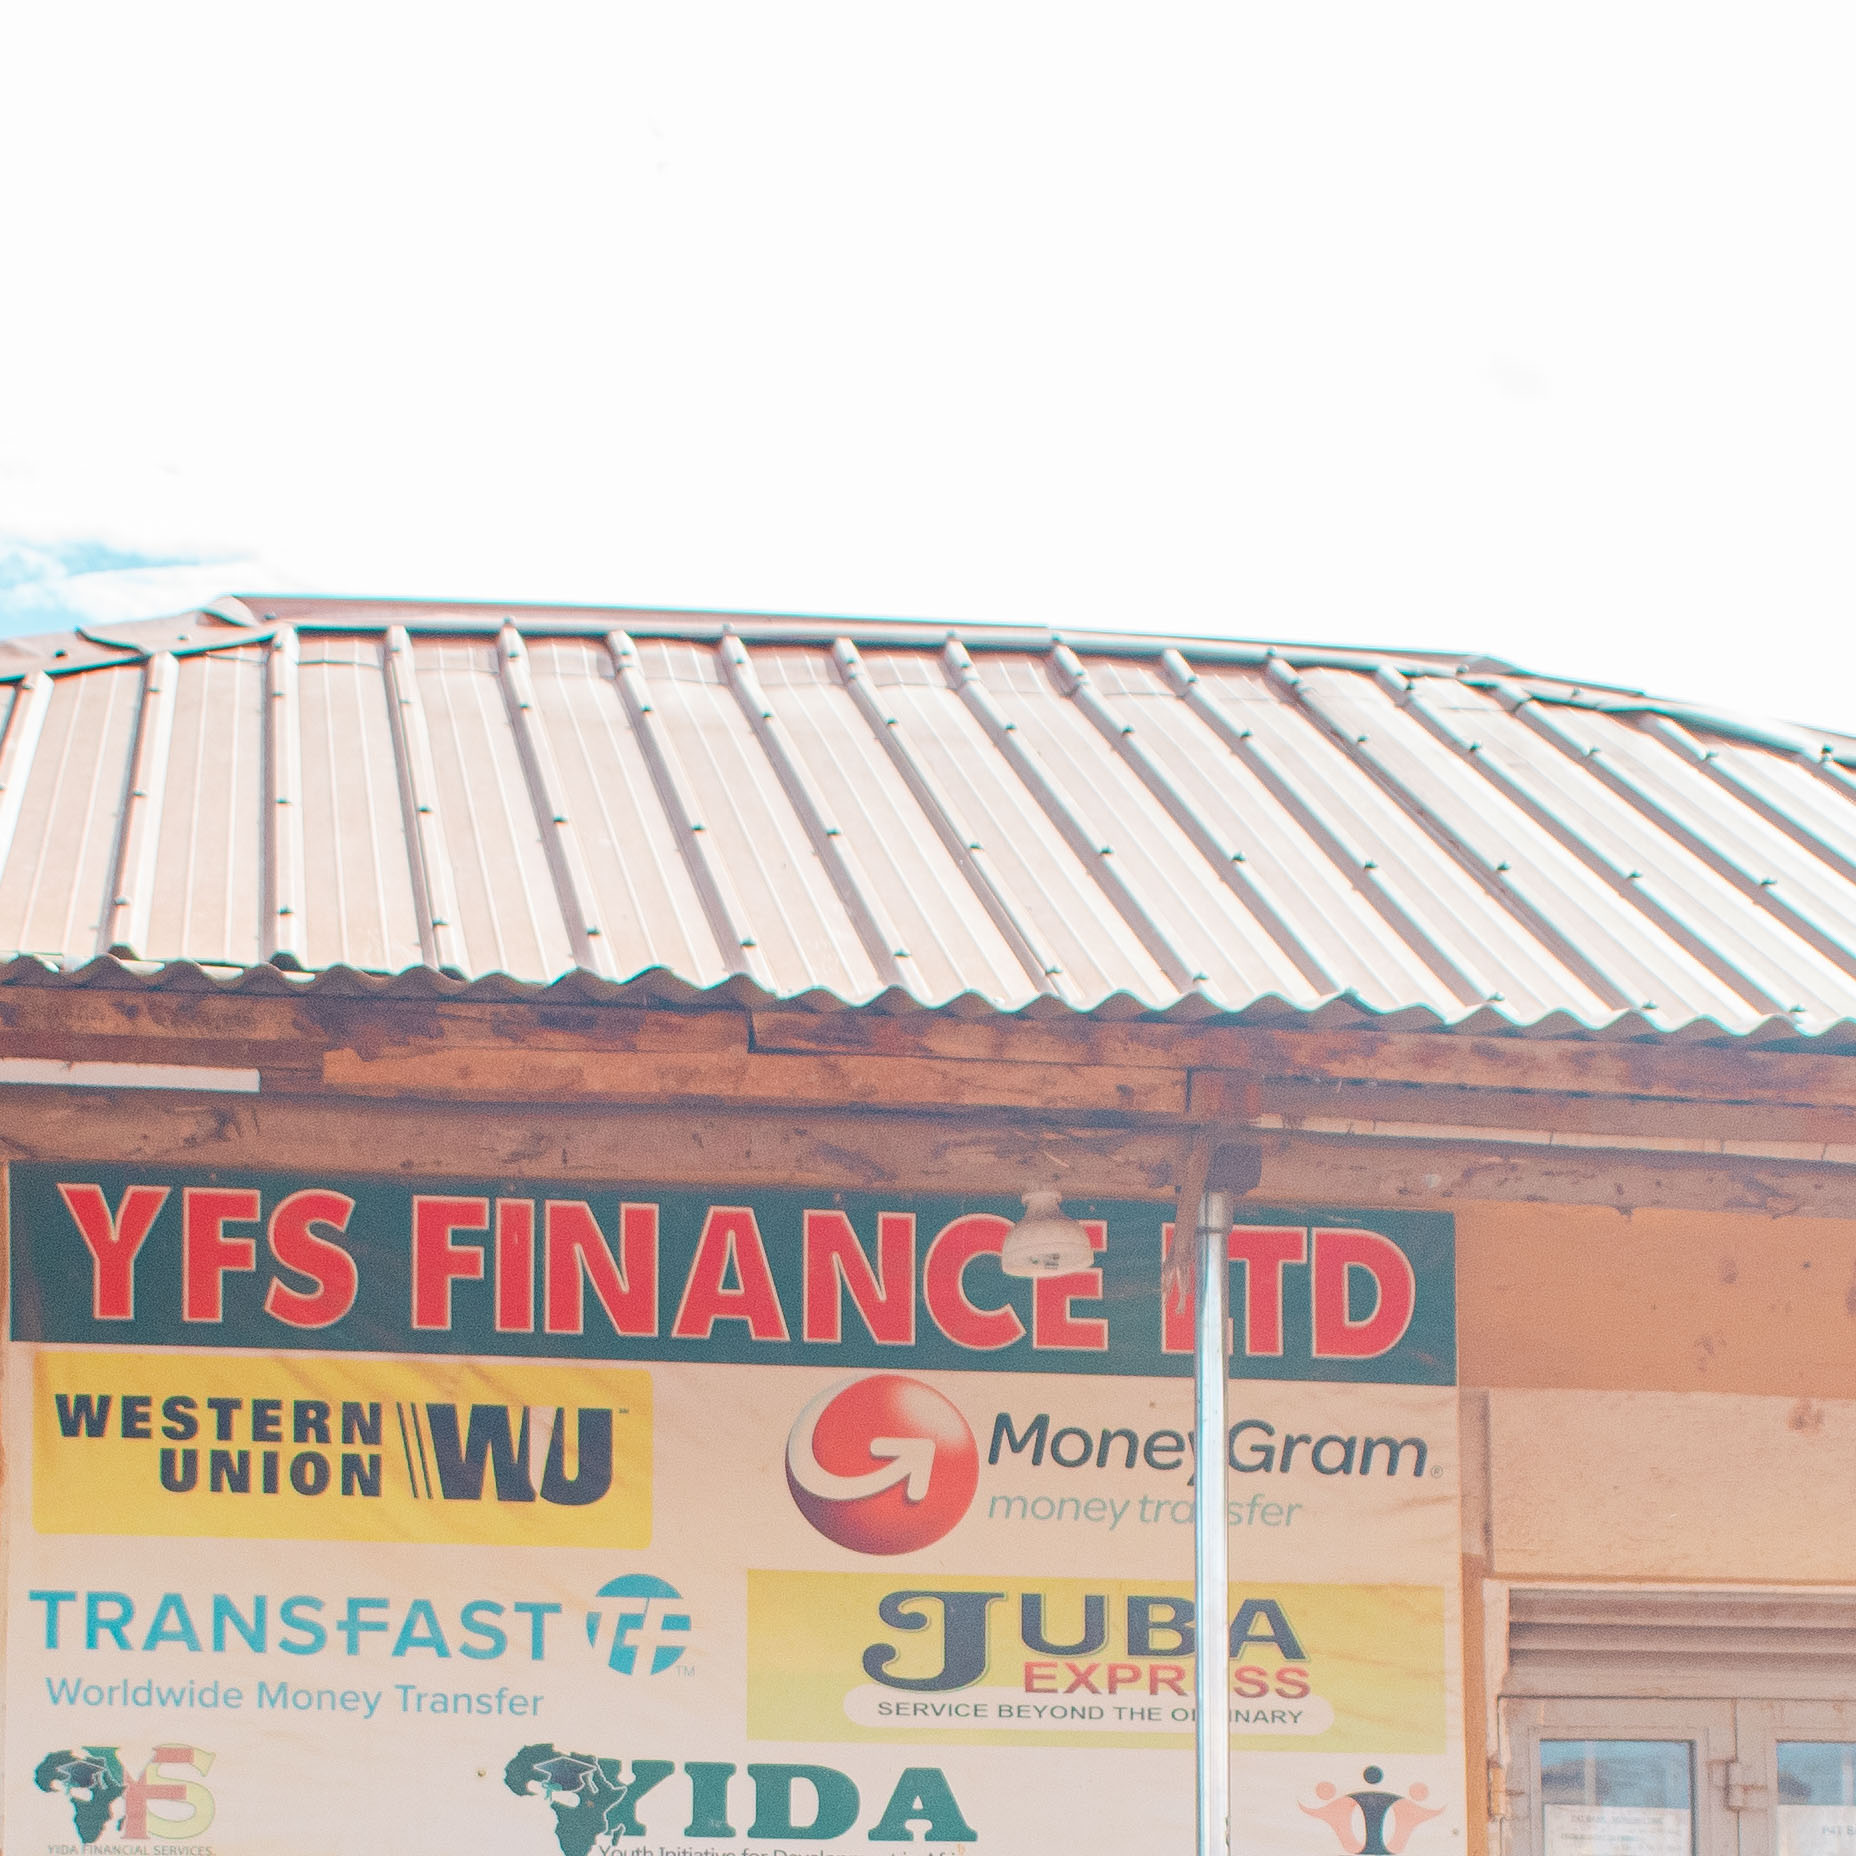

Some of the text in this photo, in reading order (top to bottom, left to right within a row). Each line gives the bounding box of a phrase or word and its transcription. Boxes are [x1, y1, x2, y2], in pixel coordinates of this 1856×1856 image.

[57, 1183, 359, 1328] YFS
[412, 1195, 1109, 1352] FINANCE
[55, 1393, 383, 1446] WESTERN
[159, 1448, 383, 1498] UNION
[427, 1402, 614, 1507] WU
[987, 1411, 1429, 1487] MoneGram
[987, 1493, 1304, 1531] money trasfer
[30, 1588, 563, 1661] TRANSFAST
[862, 1589, 1311, 1693] JUBA
[46, 1676, 545, 1720] Worldwide Money Transfer
[1024, 1661, 1312, 1700] EXPRSS
[877, 1701, 1304, 1725] SERVICE BEYOND THE OINARY
[597, 1757, 979, 1843] YIDA
[47, 1844, 81, 1856] YIDA
